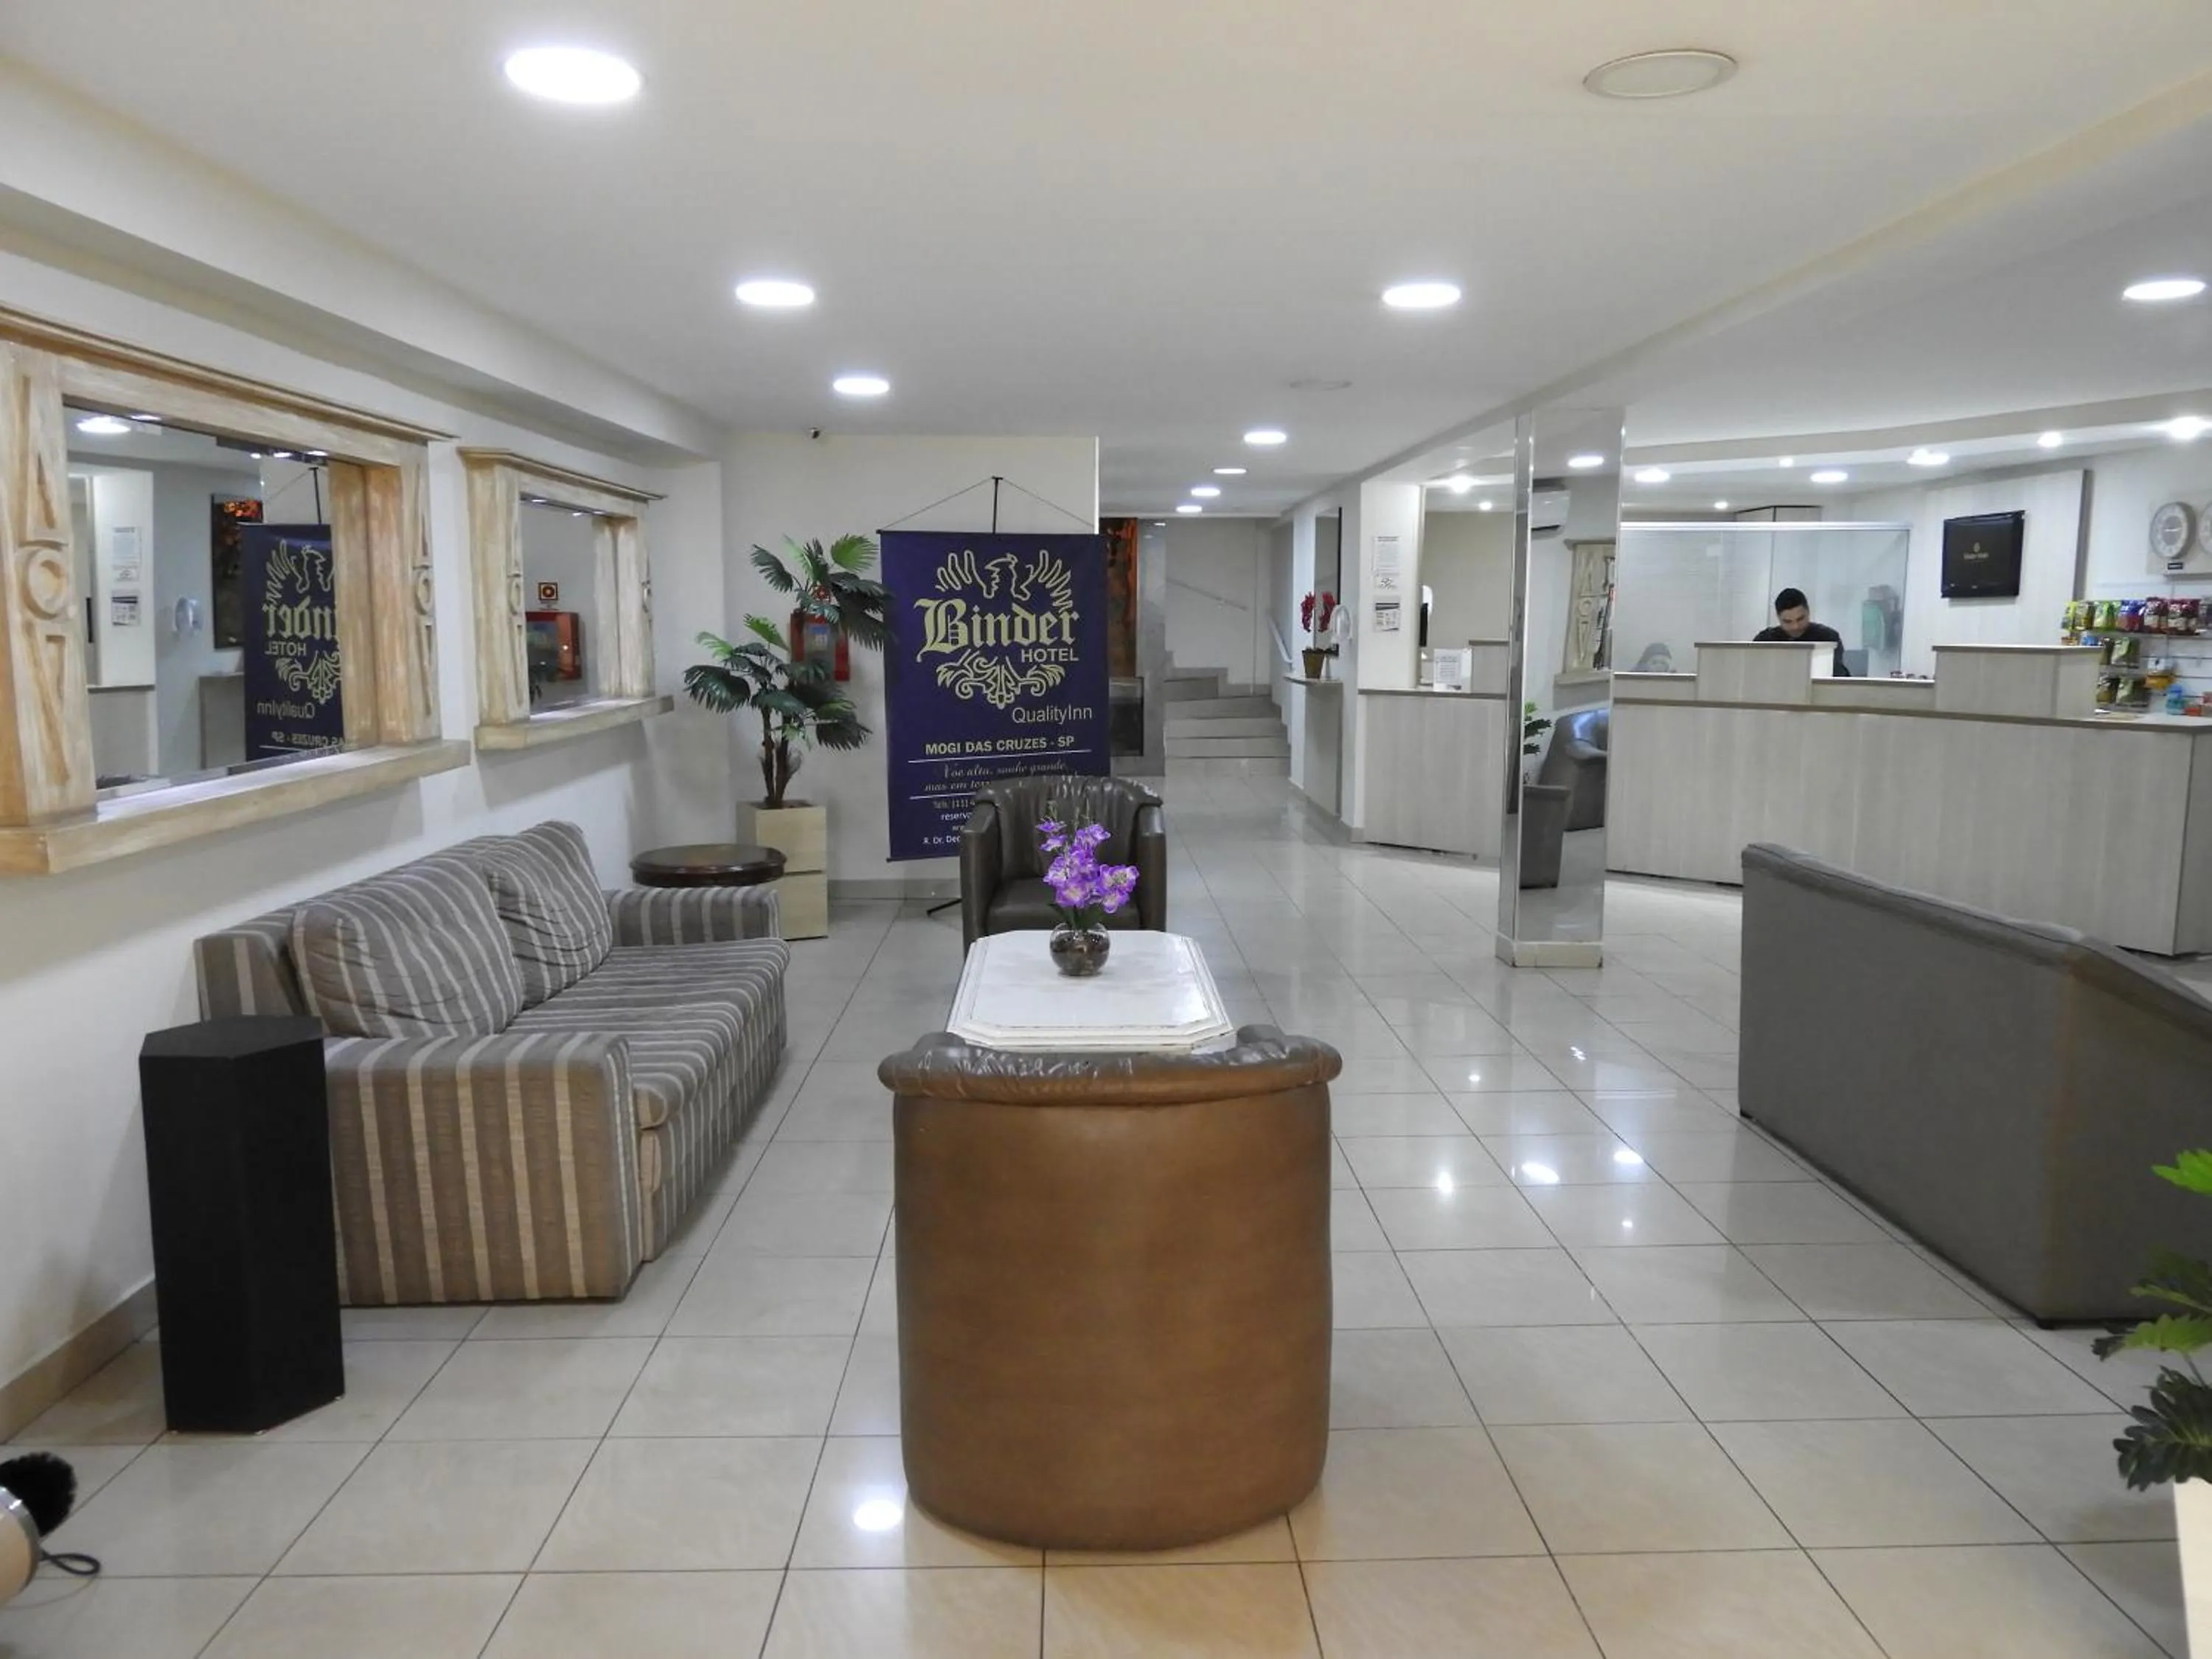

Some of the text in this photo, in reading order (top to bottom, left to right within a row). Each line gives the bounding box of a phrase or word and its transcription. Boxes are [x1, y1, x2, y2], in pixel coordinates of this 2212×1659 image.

[914, 598, 1080, 663] Binder
[1020, 647, 1079, 664] HOTEL
[1012, 704, 1093, 725] QualityInn
[925, 742, 961, 755] MOGI
[965, 740, 992, 753] DAS
[996, 737, 1048, 751] CRUZES
[1057, 735, 1075, 748] SP
